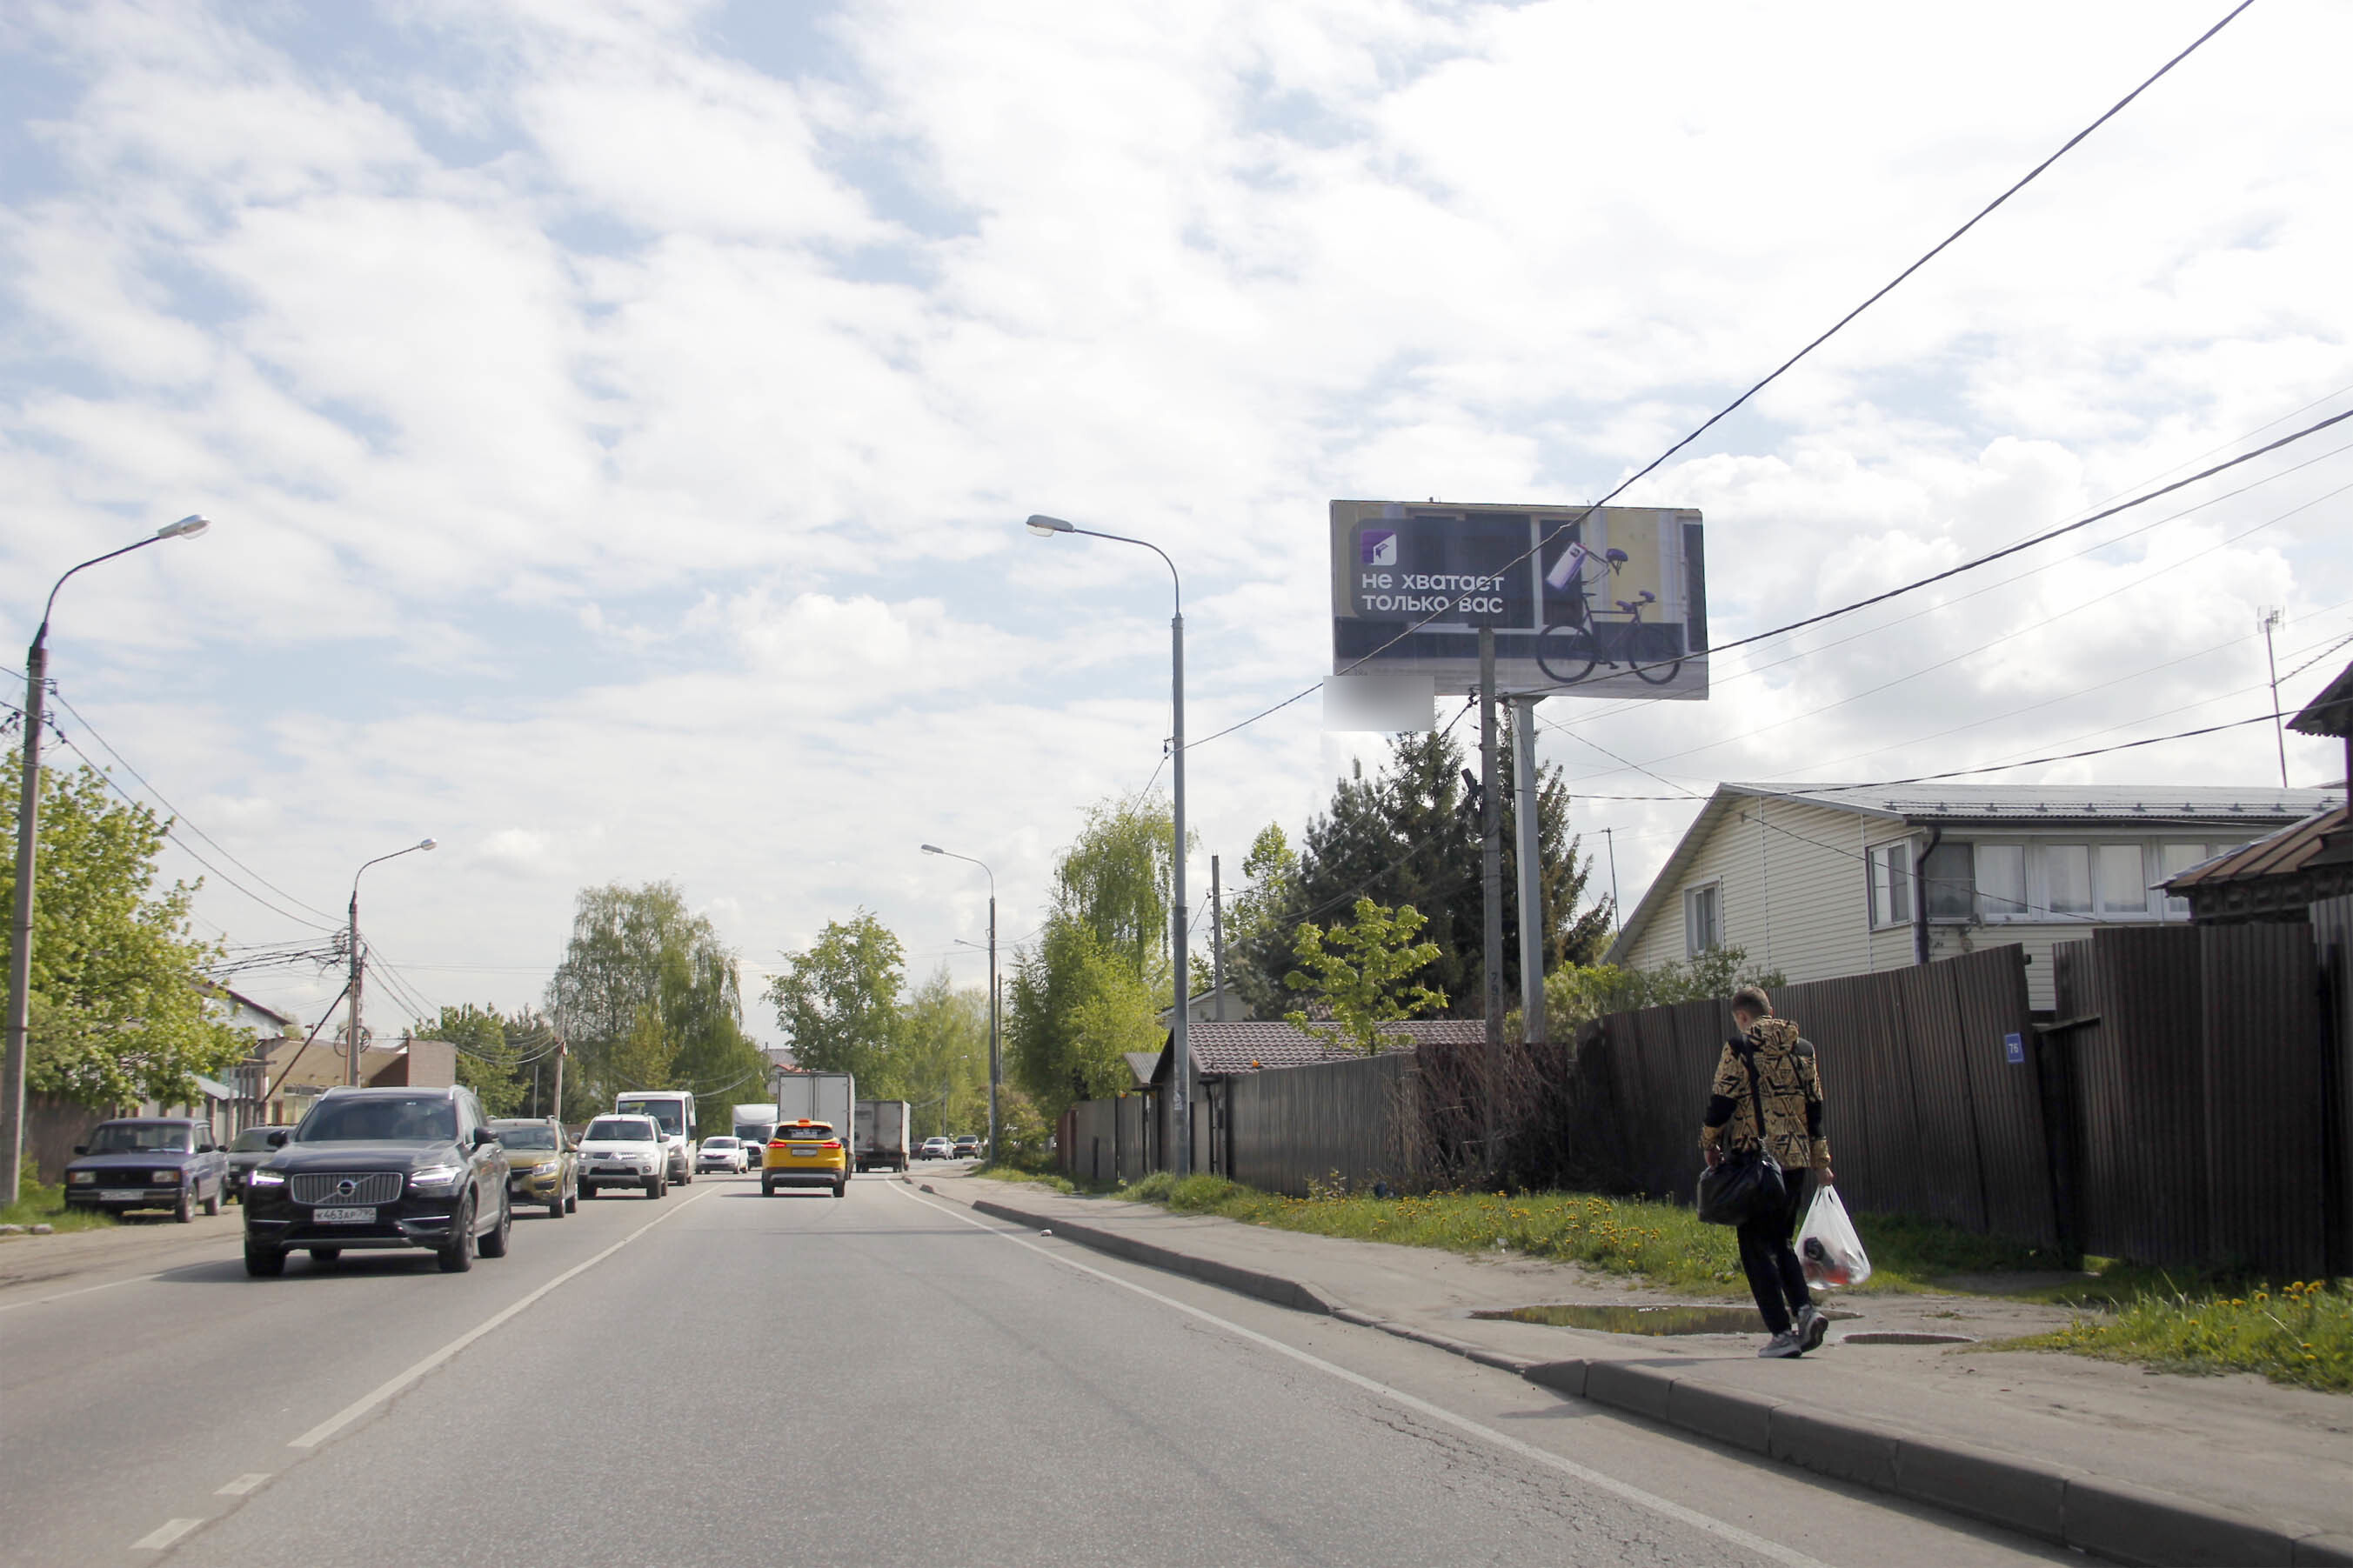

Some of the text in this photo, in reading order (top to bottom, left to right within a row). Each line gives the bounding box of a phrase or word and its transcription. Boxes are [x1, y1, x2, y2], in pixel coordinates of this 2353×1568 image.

[1361, 573, 1505, 591] не хватает
[1361, 595, 1504, 614] только вас
